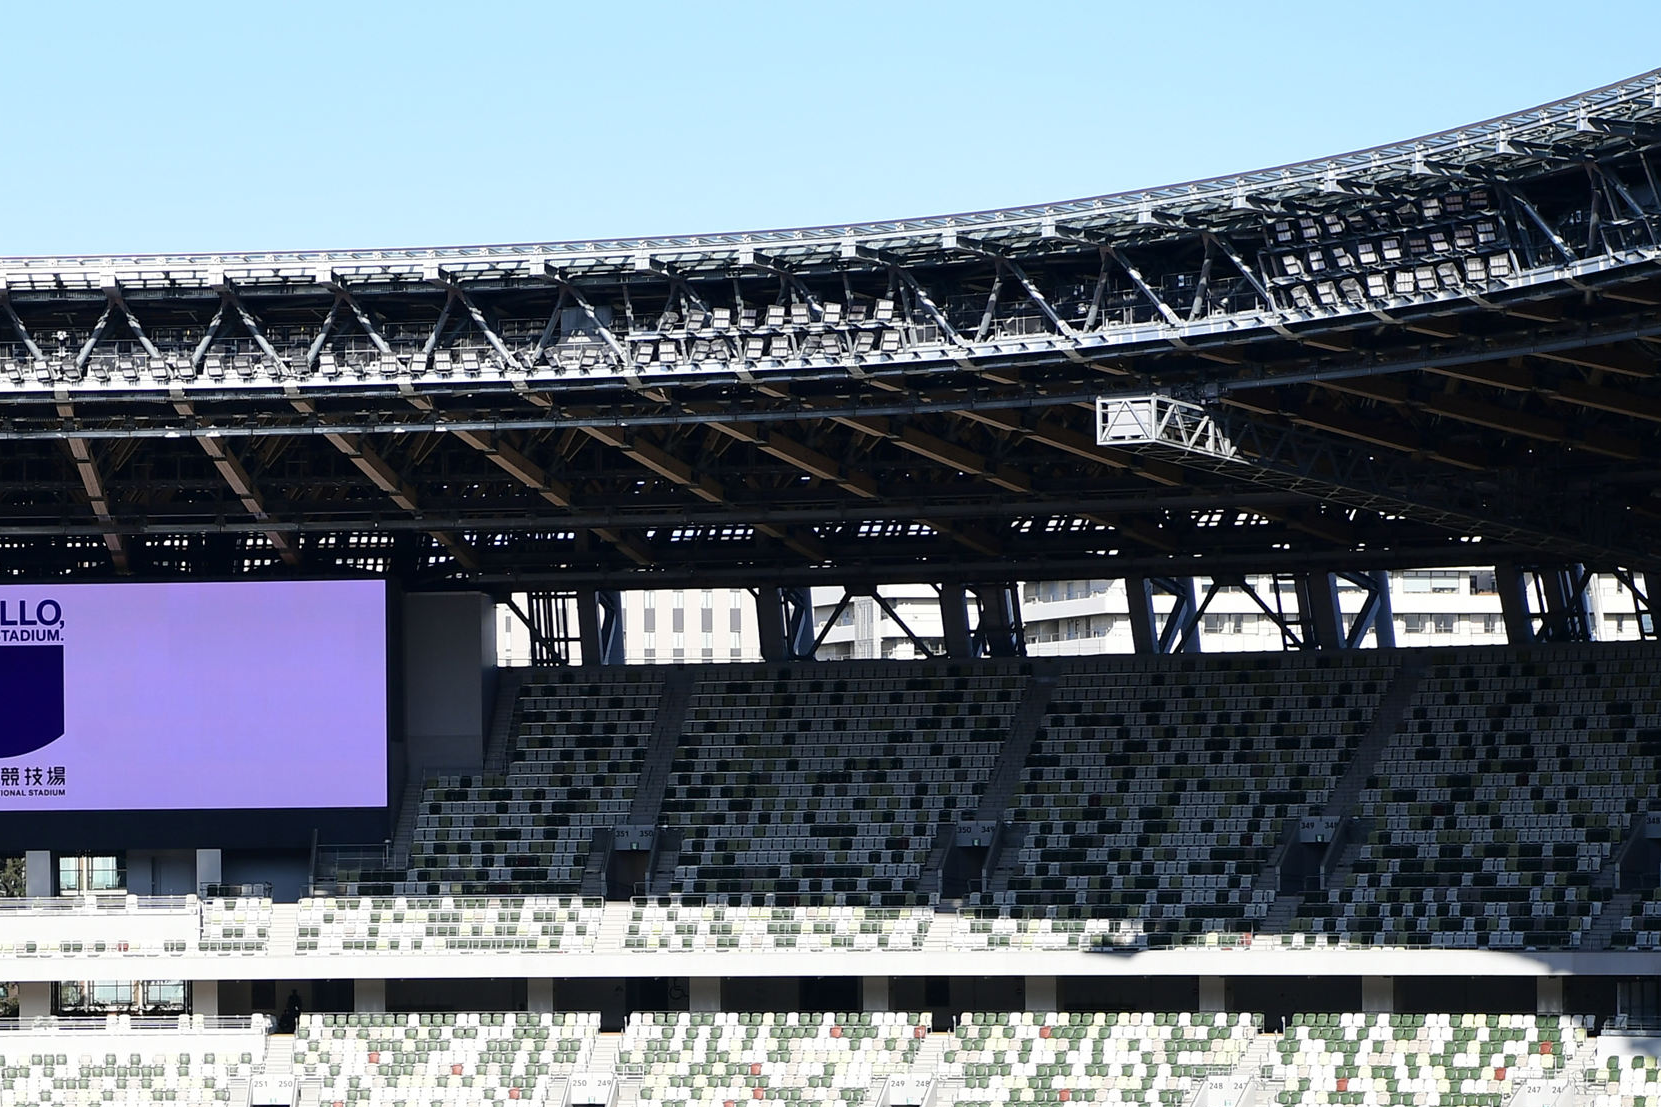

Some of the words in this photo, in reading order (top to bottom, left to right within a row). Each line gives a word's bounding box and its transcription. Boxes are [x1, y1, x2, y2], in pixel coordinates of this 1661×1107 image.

[28, 789, 66, 797] STADIUM
[957, 826, 972, 834] 350
[1301, 822, 1315, 830] 349
[639, 830, 654, 838] 350
[253, 1080, 268, 1088] 251
[278, 1080, 293, 1088] 250
[572, 1080, 588, 1088] 250
[890, 1080, 906, 1088] 249
[915, 1080, 930, 1088] 248
[1208, 1082, 1224, 1090] 248
[1527, 1086, 1542, 1094] 247
[1551, 1086, 1564, 1094] 24
